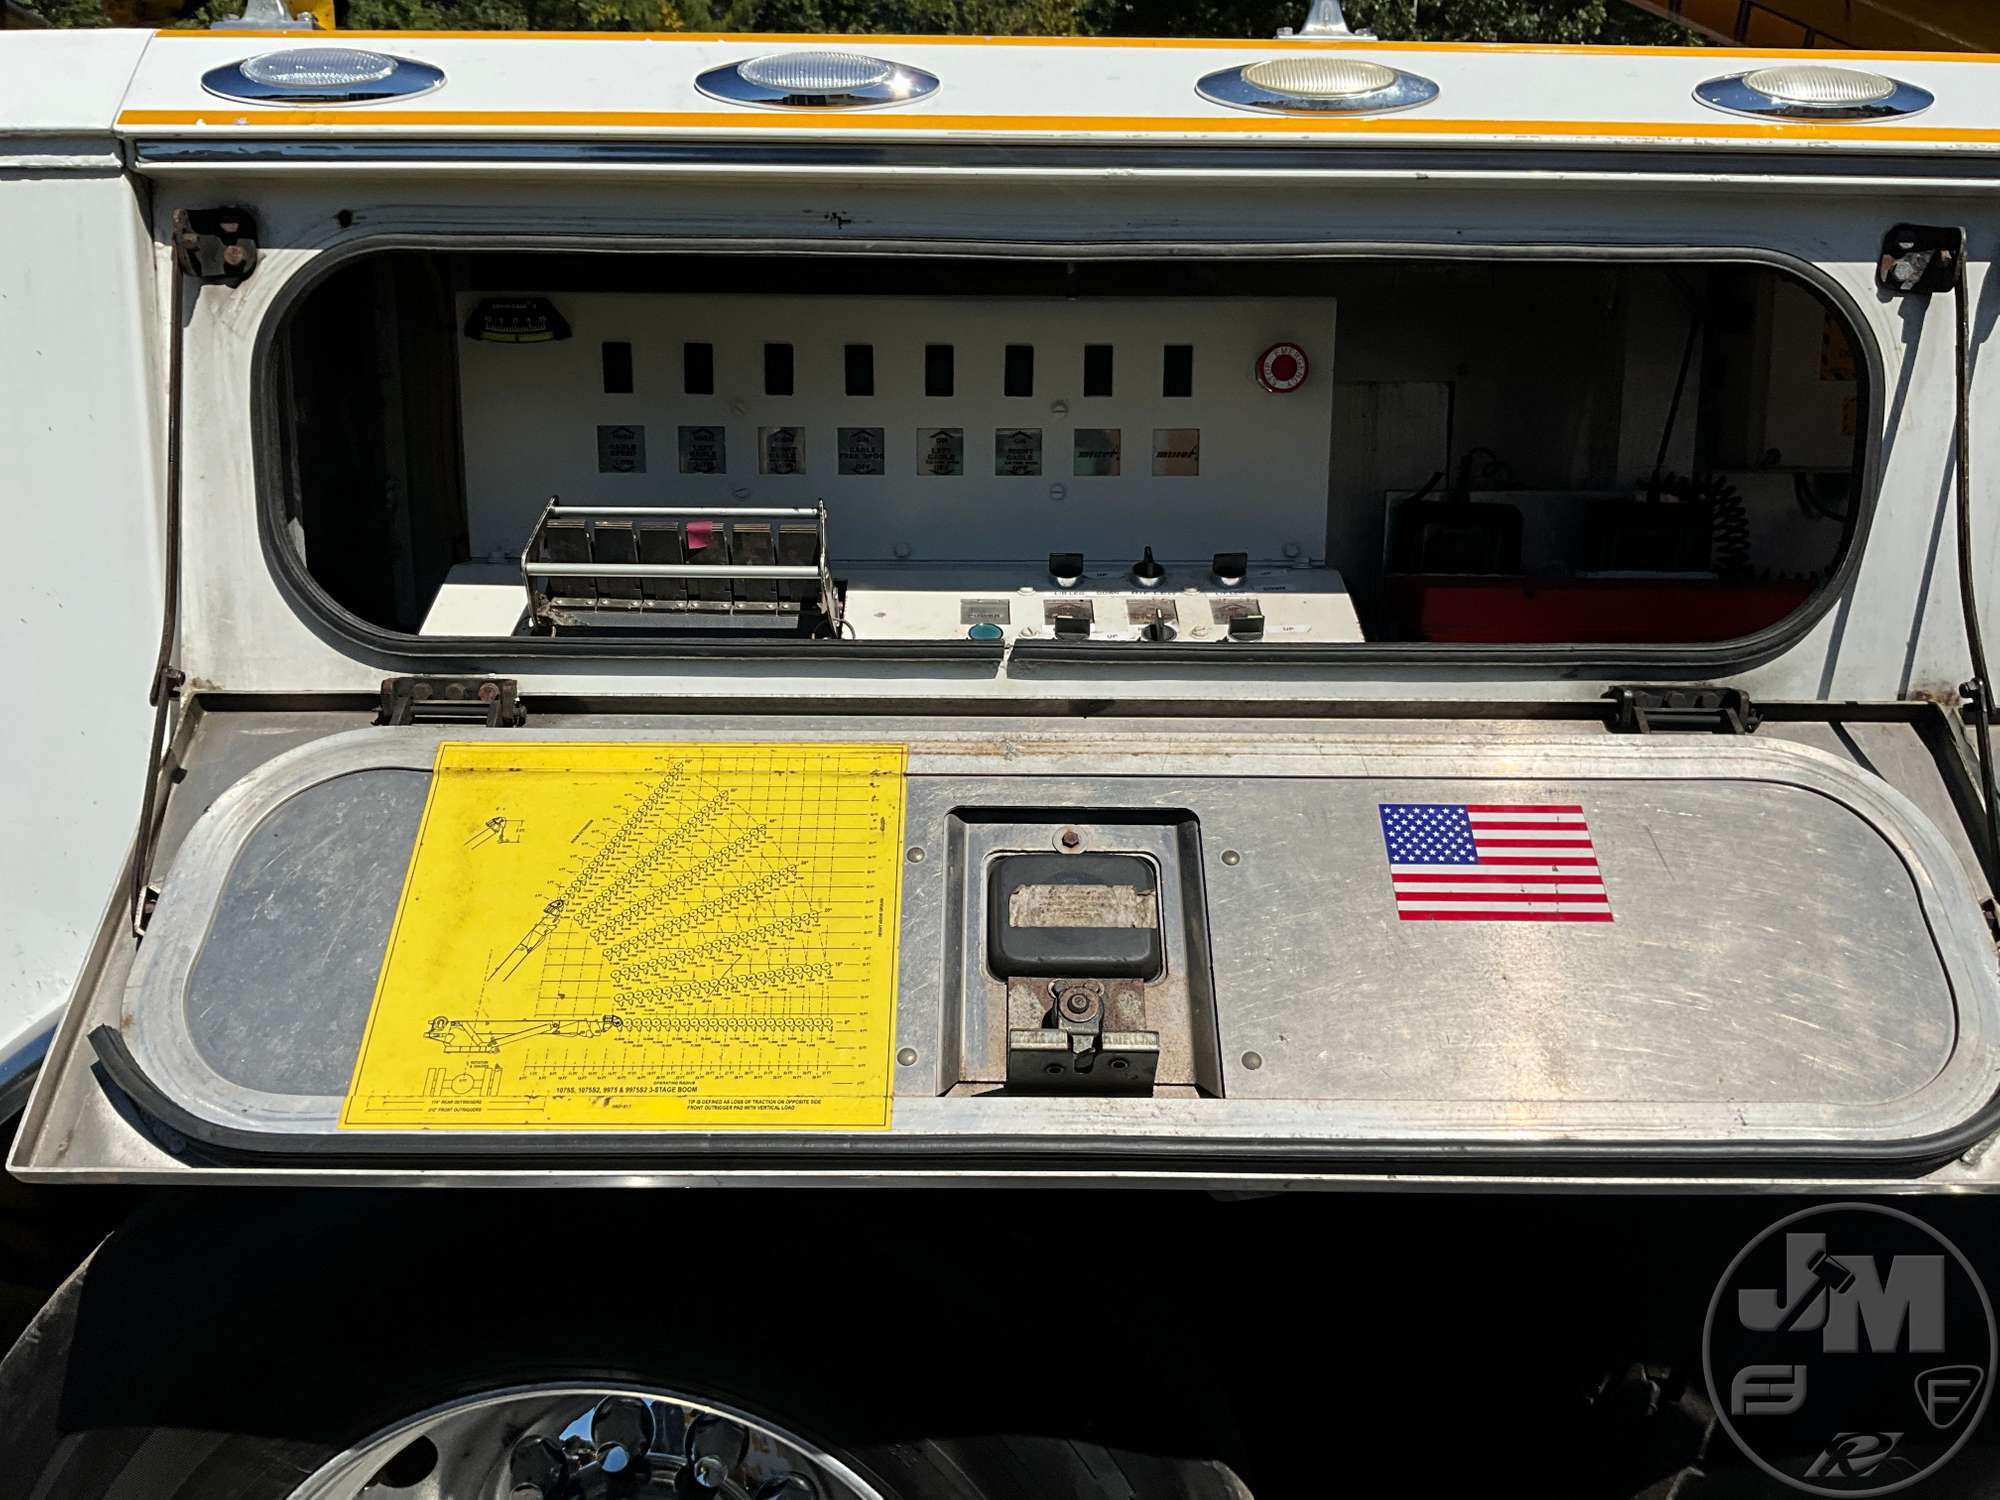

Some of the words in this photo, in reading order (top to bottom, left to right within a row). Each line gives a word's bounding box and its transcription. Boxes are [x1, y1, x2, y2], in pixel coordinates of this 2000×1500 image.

[619, 1086, 624, 1094] &
[648, 1086, 677, 1094] 3-STAGE
[677, 1086, 698, 1094] BOOM
